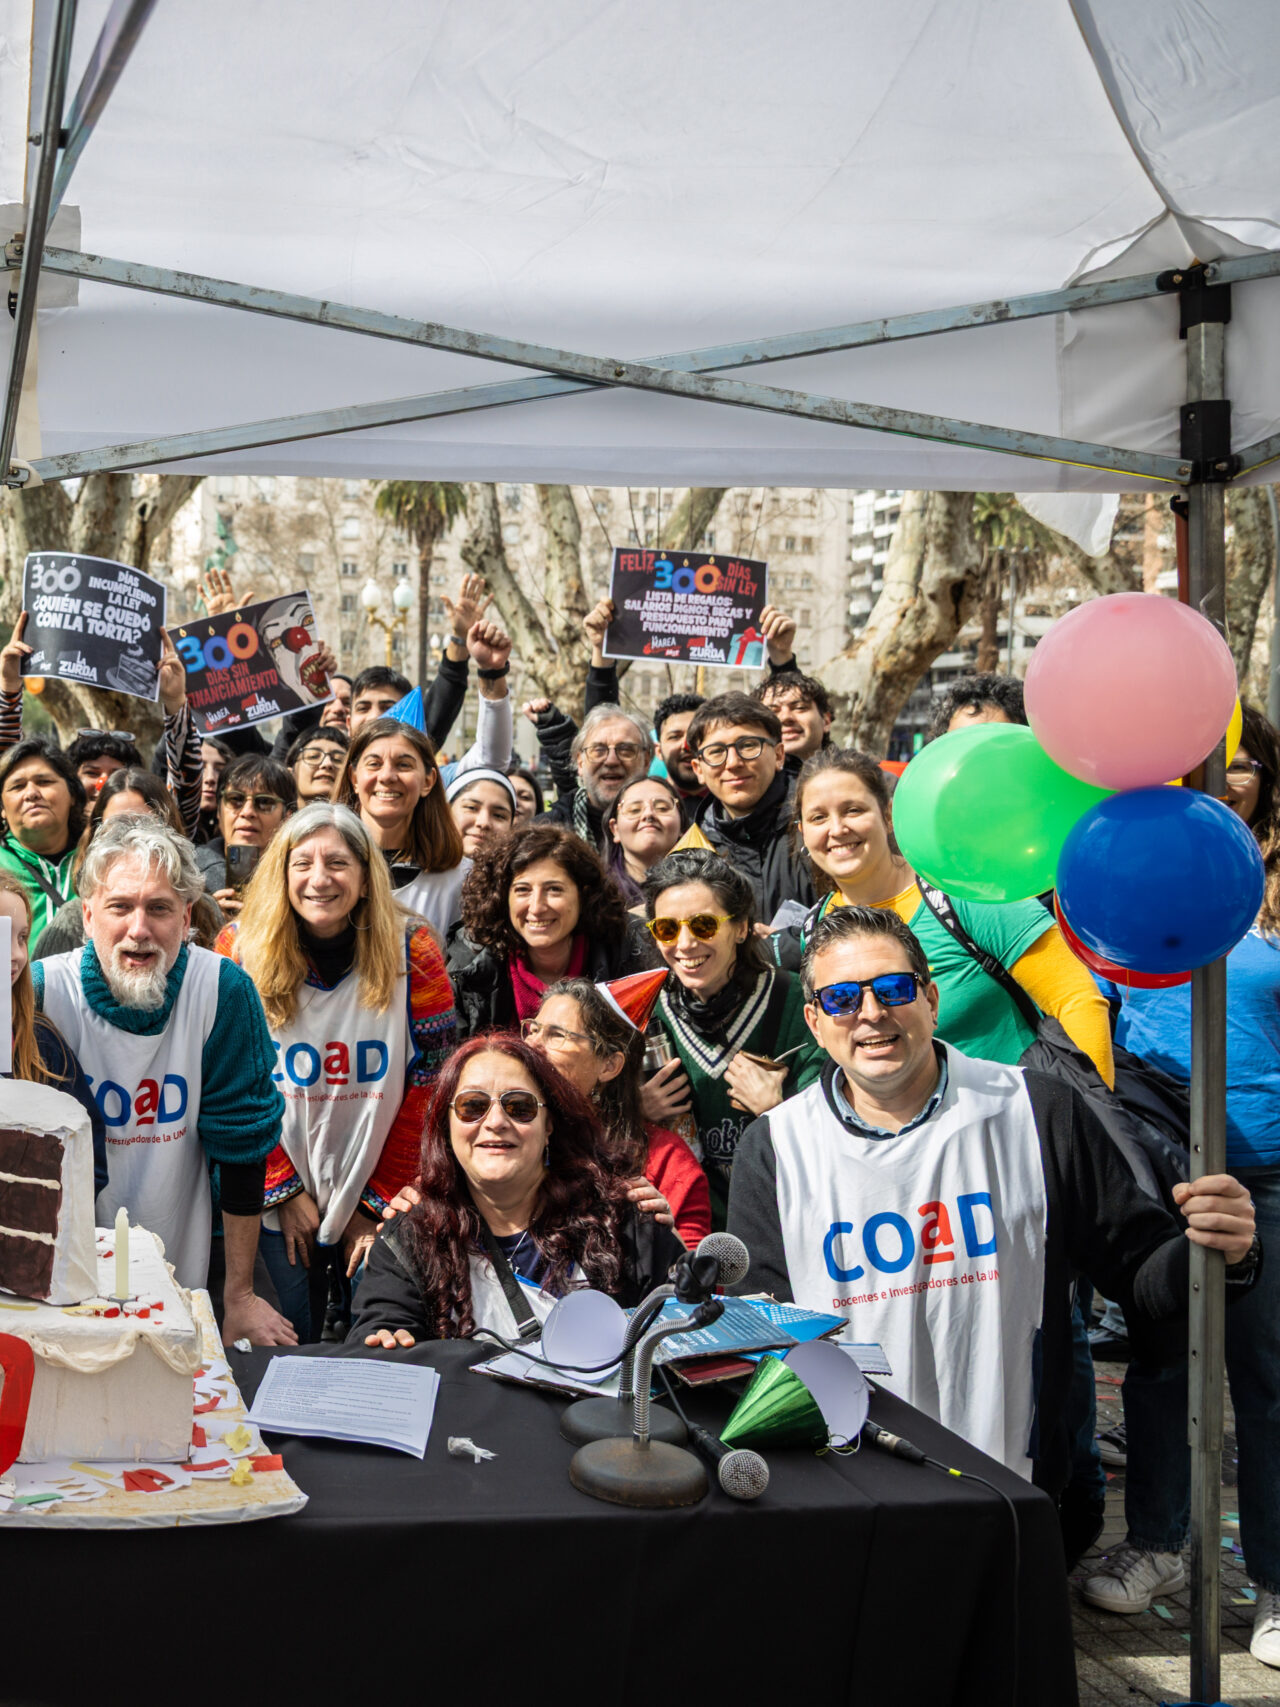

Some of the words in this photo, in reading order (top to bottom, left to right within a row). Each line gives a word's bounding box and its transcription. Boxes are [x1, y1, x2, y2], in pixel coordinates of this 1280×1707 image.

[30, 564, 81, 594] 300
[118, 570, 140, 587] DÍAS
[653, 560, 723, 594] 300
[727, 561, 751, 580] DÍAS
[88, 576, 157, 607] INCUMPLIENDO
[645, 590, 673, 603] LISTA
[674, 593, 686, 603] DE
[717, 577, 736, 593] SIN
[738, 580, 758, 597] LEY
[108, 592, 123, 606] LA
[123, 596, 141, 611] LEY
[624, 599, 672, 612] SALARIOS
[712, 607, 744, 619] BECAS
[745, 608, 753, 620] Y
[32, 594, 81, 614] ¿QUIÉN
[82, 600, 103, 618] SE
[104, 606, 151, 632] QUEDÓ
[640, 611, 708, 626] PRESUPUESTO
[708, 616, 734, 628] PARA
[36, 611, 63, 628] CON
[63, 614, 83, 632] LA
[87, 618, 142, 644] TORTA?
[642, 622, 729, 638] FUNCIONAMIENTO
[176, 622, 259, 673] 300
[689, 647, 726, 662] ZURDA
[59, 661, 97, 681] ZURDA
[205, 666, 230, 686] DÍAS
[231, 661, 250, 678] SIN
[186, 668, 279, 709] FINANCIAMIENTO
[245, 700, 281, 718] ZURDA
[152, 1134, 161, 1143] de
[163, 1133, 171, 1142] la
[832, 1291, 879, 1309] Docentes
[881, 1290, 888, 1299] e
[960, 1272, 974, 1284] de
[976, 1270, 987, 1282] la
